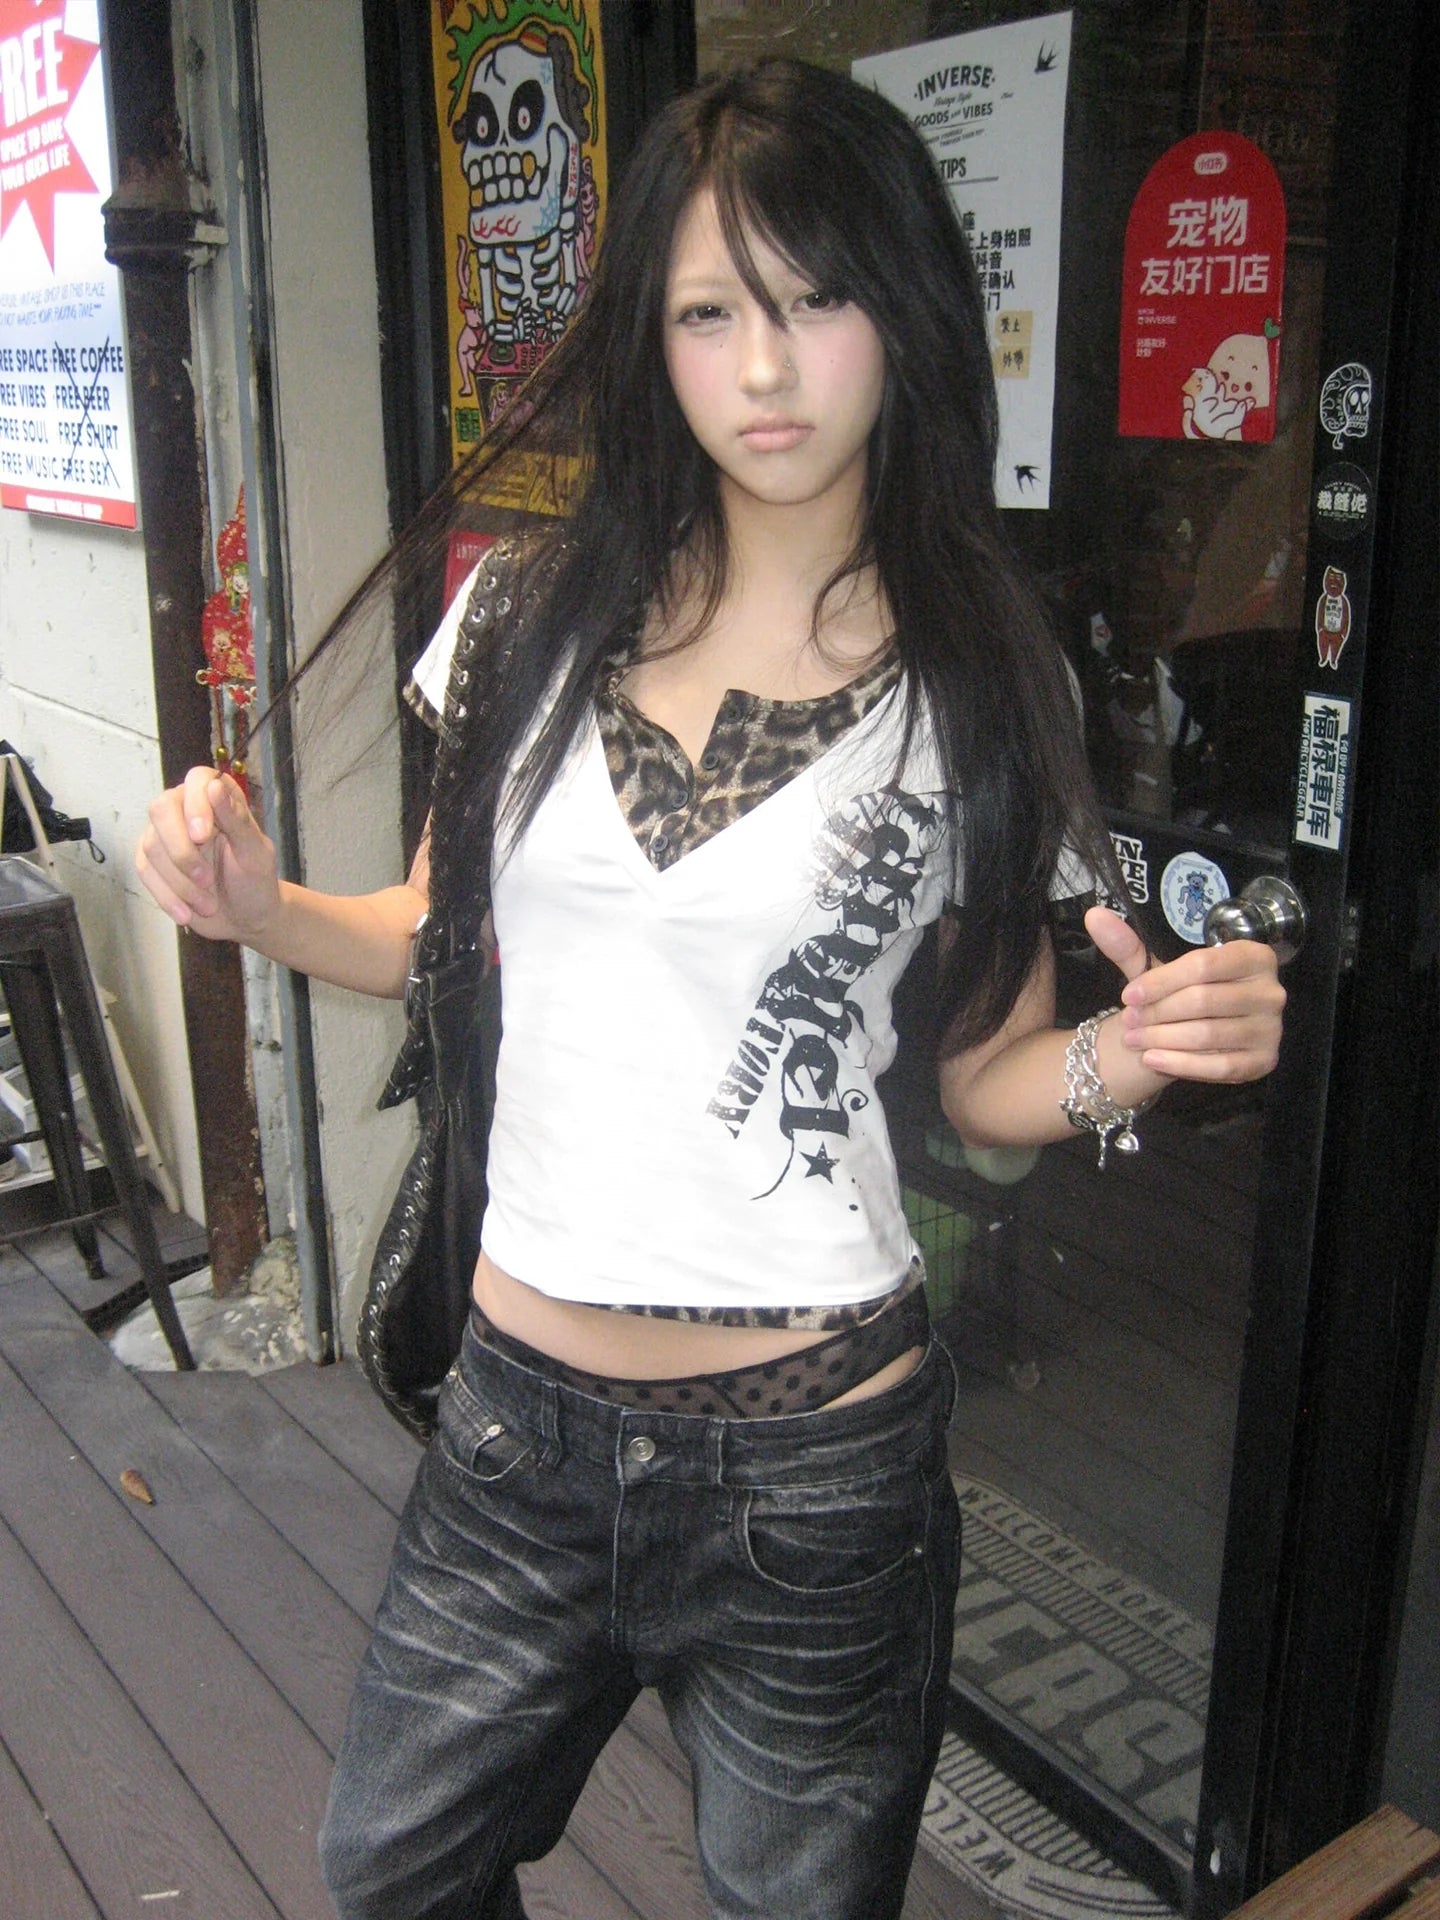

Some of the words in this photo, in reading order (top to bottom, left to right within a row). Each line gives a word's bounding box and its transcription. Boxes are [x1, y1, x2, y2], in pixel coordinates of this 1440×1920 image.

[0, 17, 68, 127] REE
[917, 65, 994, 101] INVERSE
[914, 110, 950, 127] GOODS
[962, 102, 994, 119] VIBES
[940, 157, 967, 179] TIPS
[1166, 196, 1249, 248] 宠物
[1139, 254, 1271, 297] 友好门店
[0, 349, 14, 373] REE
[16, 349, 49, 373] SPACE
[52, 347, 78, 374] FREE
[80, 346, 124, 374] COFFEE
[19, 384, 47, 408] VIBES
[55, 385, 82, 410] FREE
[83, 386, 111, 412] BEER
[22, 419, 49, 444] SOUL
[58, 422, 83, 447] FREE
[86, 425, 119, 450] SHIRT
[2, 452, 23, 476] FREE
[25, 454, 59, 480] MUSIC
[62, 459, 86, 484] FREE
[90, 461, 110, 487] SEX
